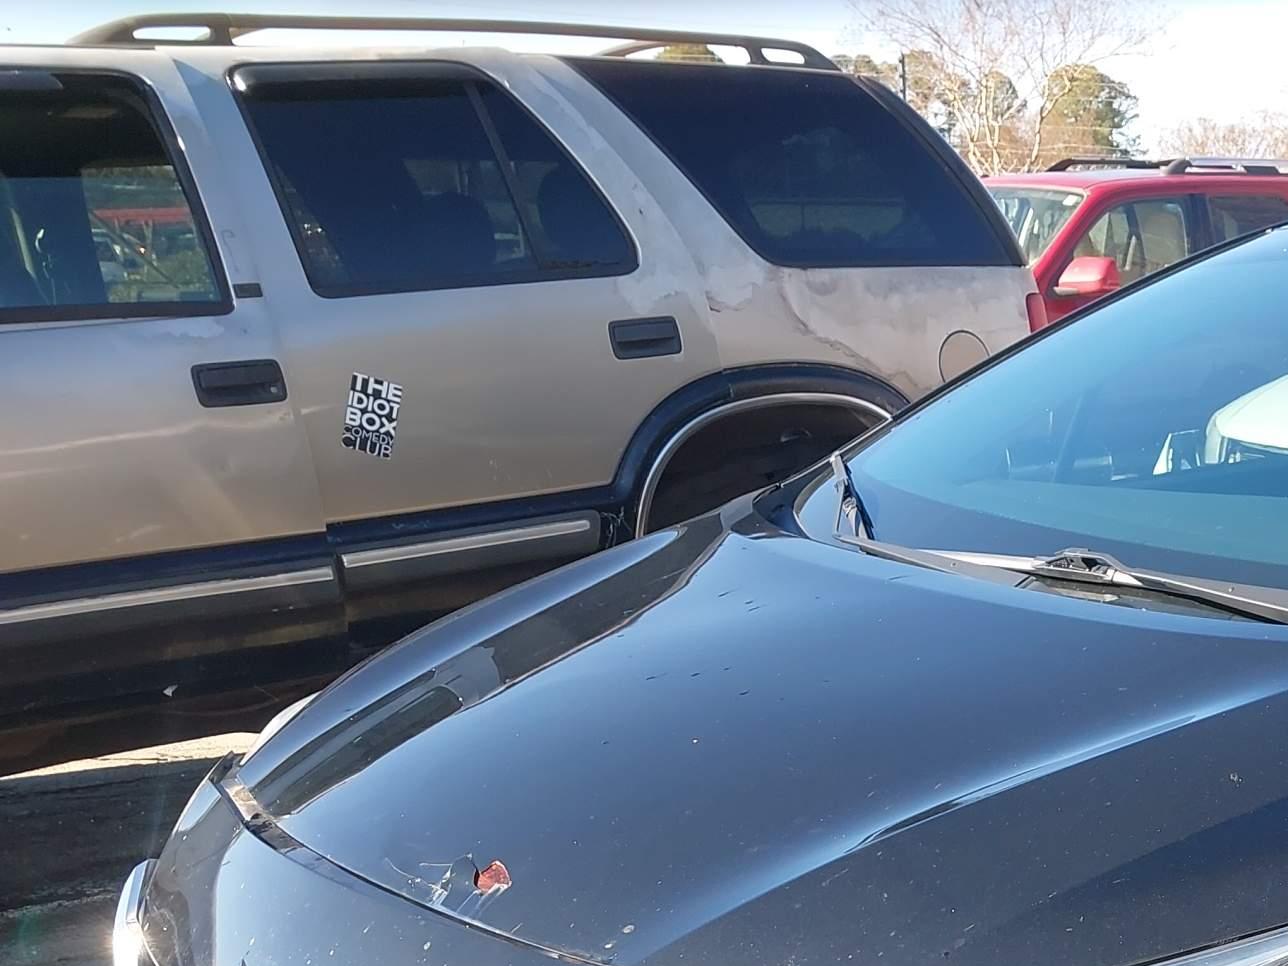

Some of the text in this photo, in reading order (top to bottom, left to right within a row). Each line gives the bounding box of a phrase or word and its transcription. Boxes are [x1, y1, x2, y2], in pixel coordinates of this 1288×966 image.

[352, 371, 403, 403] THE
[348, 389, 401, 419] IDIOT
[343, 424, 394, 447] COMEDY
[345, 406, 397, 438] BOX
[341, 433, 392, 460] CLUB
